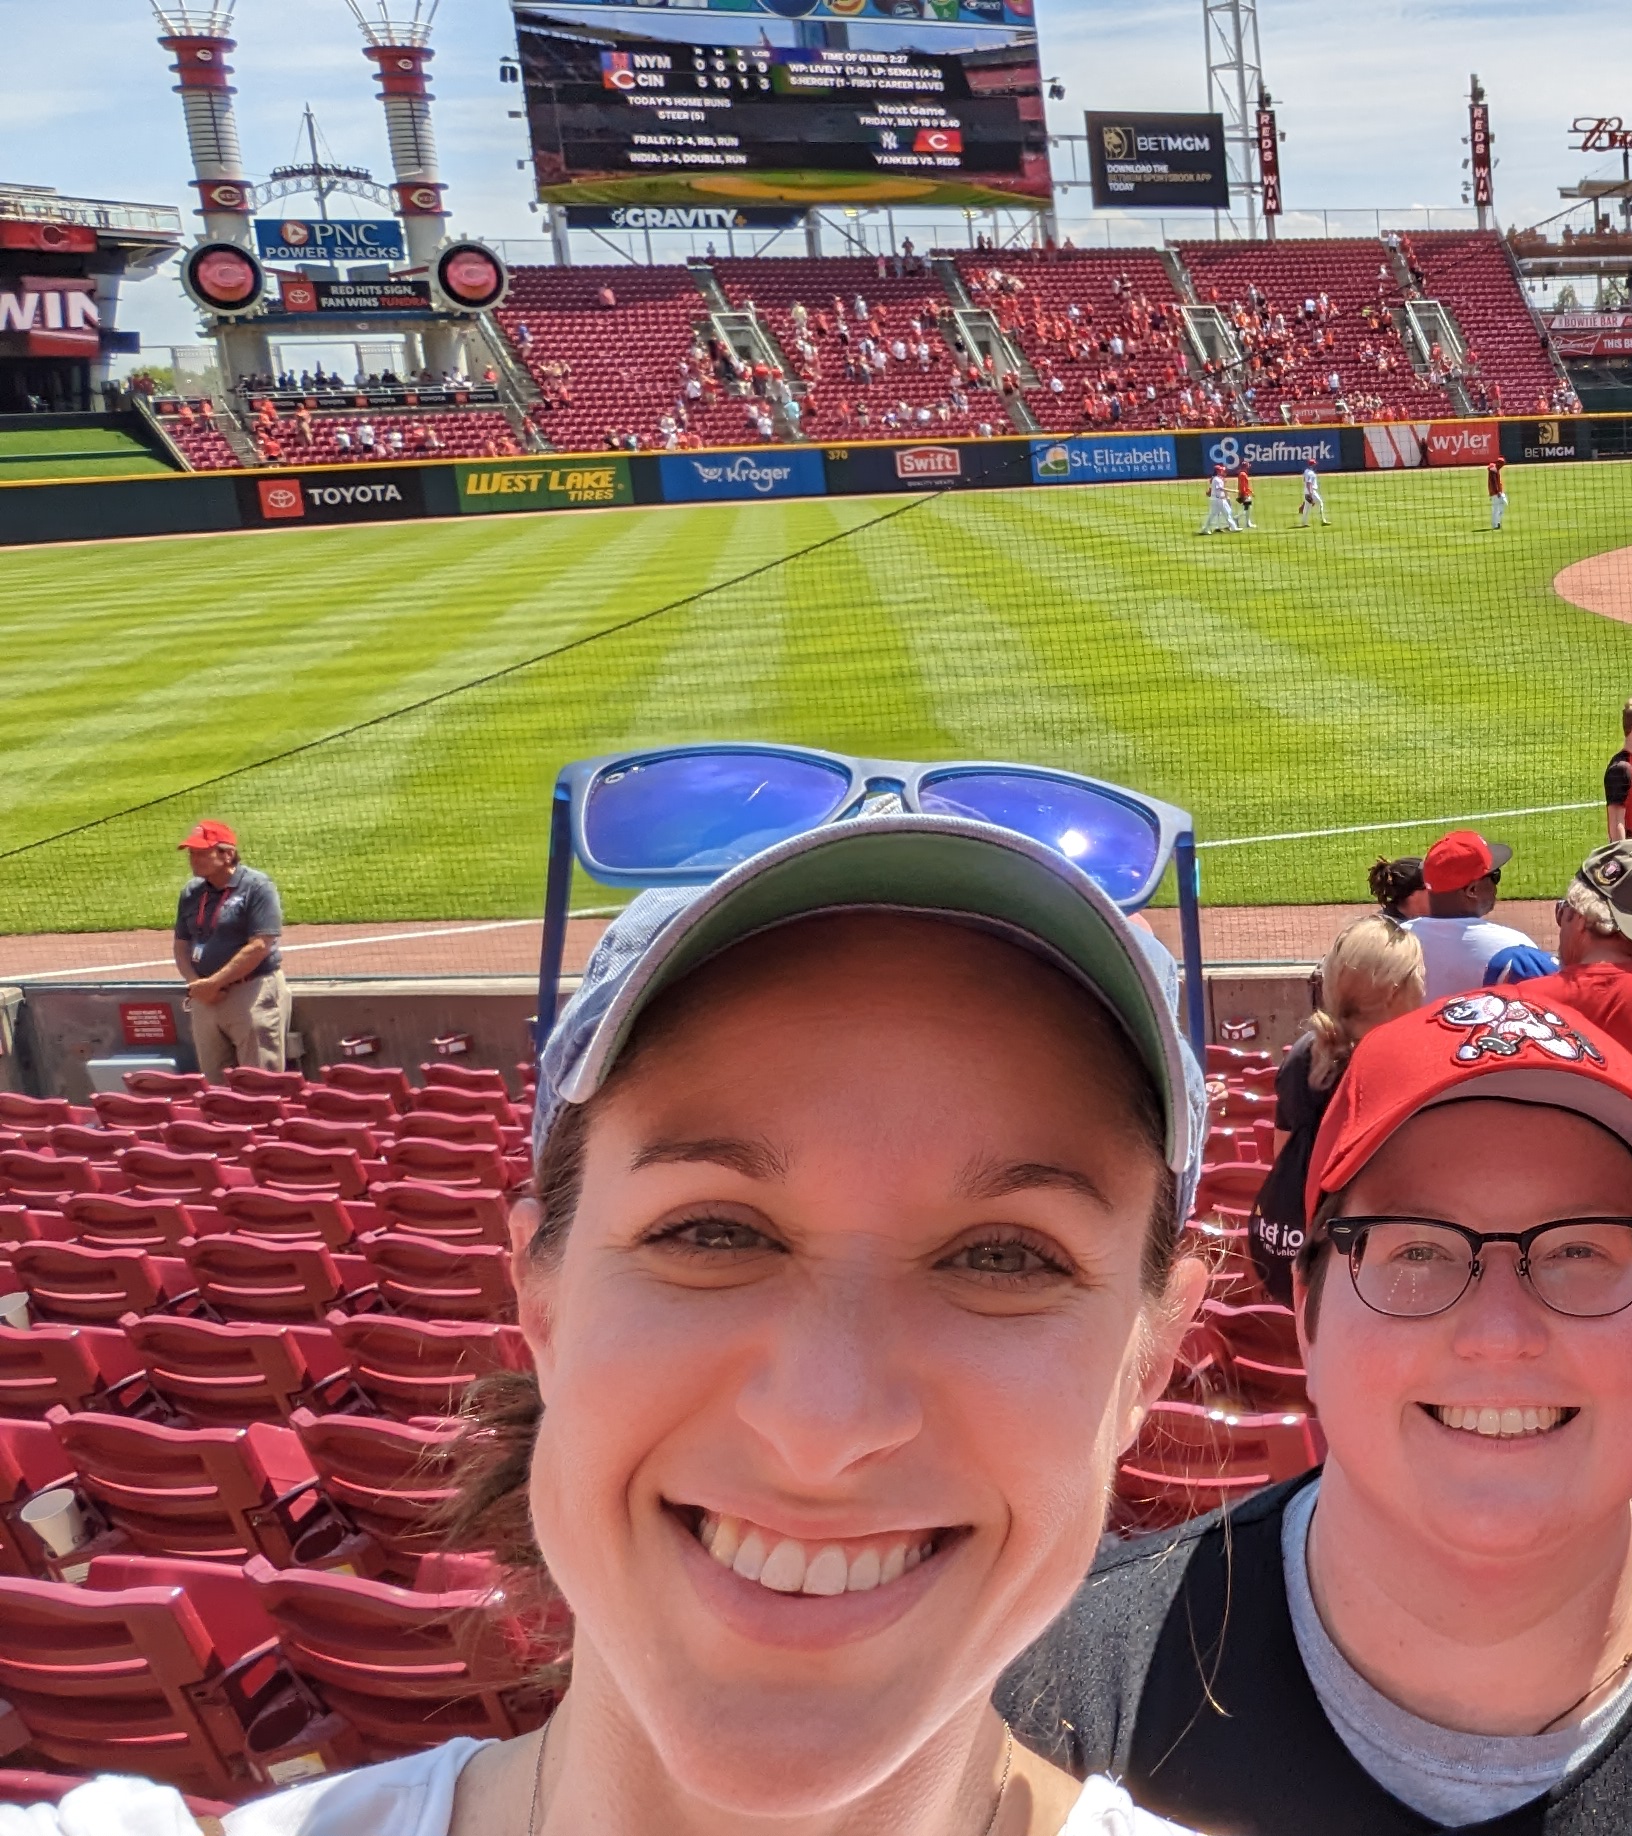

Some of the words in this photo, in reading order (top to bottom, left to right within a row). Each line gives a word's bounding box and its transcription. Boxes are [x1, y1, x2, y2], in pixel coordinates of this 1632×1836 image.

[633, 55, 672, 69] NYM
[696, 60, 705, 70] 0
[716, 60, 725, 71] 6
[737, 61, 747, 72] 0
[758, 62, 767, 73] 9
[822, 52, 844, 62] TIME
[847, 53, 860, 62] OF
[890, 54, 908, 64] 2:27
[789, 63, 808, 73] WP:
[809, 64, 843, 74] LIVELY
[845, 66, 868, 76] (1-0)
[872, 67, 886, 76] LP:
[887, 67, 918, 77] SENGA
[637, 74, 664, 87] CIN
[698, 77, 707, 88] 5
[715, 77, 730, 88] 10
[741, 78, 748, 89] 1
[759, 79, 769, 90] 3
[851, 78, 877, 88] FIRST
[878, 79, 914, 90] CAREER
[628, 96, 672, 106] TODAY'S
[674, 98, 703, 107] HOME
[704, 99, 731, 108] RUNS
[658, 111, 689, 120] STEER
[878, 104, 908, 114] Next
[909, 105, 946, 116] Game
[860, 117, 896, 127] FRIDAY,
[898, 117, 919, 127] MAY
[1473, 108, 1486, 153] REDS
[634, 135, 675, 145] FRALEY:
[677, 136, 696, 146] 2-4,
[717, 137, 738, 147] RUN
[1137, 136, 1210, 151] BETMGM
[1260, 114, 1273, 161] REDS
[630, 153, 661, 163] INDIA:
[662, 154, 682, 164] 2-4,
[683, 154, 724, 165] DOUBLE,
[726, 155, 747, 165] RUN
[875, 155, 919, 166] YANKEES
[936, 156, 960, 166] REDS
[272, 163, 371, 177] CINCINNATI
[1107, 165, 1152, 173] DOWNLOAD
[1153, 165, 1169, 173] THE
[1109, 183, 1135, 191] TODAY
[1475, 167, 1489, 200] WIN
[1264, 175, 1277, 209] WIN
[311, 223, 380, 245] PNC
[266, 247, 328, 258] POWER
[335, 247, 400, 259] STACKS
[331, 286, 354, 295] RED
[357, 286, 382, 295] HITS
[384, 286, 416, 296] SIGN,
[321, 298, 348, 307] FAN
[349, 297, 379, 307] WINS
[381, 298, 427, 306] TUNDRA
[1564, 317, 1598, 327] BOWTIE
[1601, 317, 1618, 327] BAR
[1603, 339, 1622, 349] THIS
[1431, 430, 1491, 455] wyler
[828, 451, 848, 461] 370
[1071, 450, 1092, 467] St.
[1093, 447, 1171, 466] Elizabeth
[1243, 440, 1332, 462] Staffmark
[1524, 446, 1575, 458] BETMGM
[903, 453, 953, 471] Swift
[726, 457, 791, 492] Kroger
[1095, 465, 1171, 473] HEALTHCARE
[467, 472, 544, 494] WEST
[549, 467, 616, 490] LAKE
[309, 485, 402, 506] TOYOTA
[568, 489, 614, 501] TIRES
